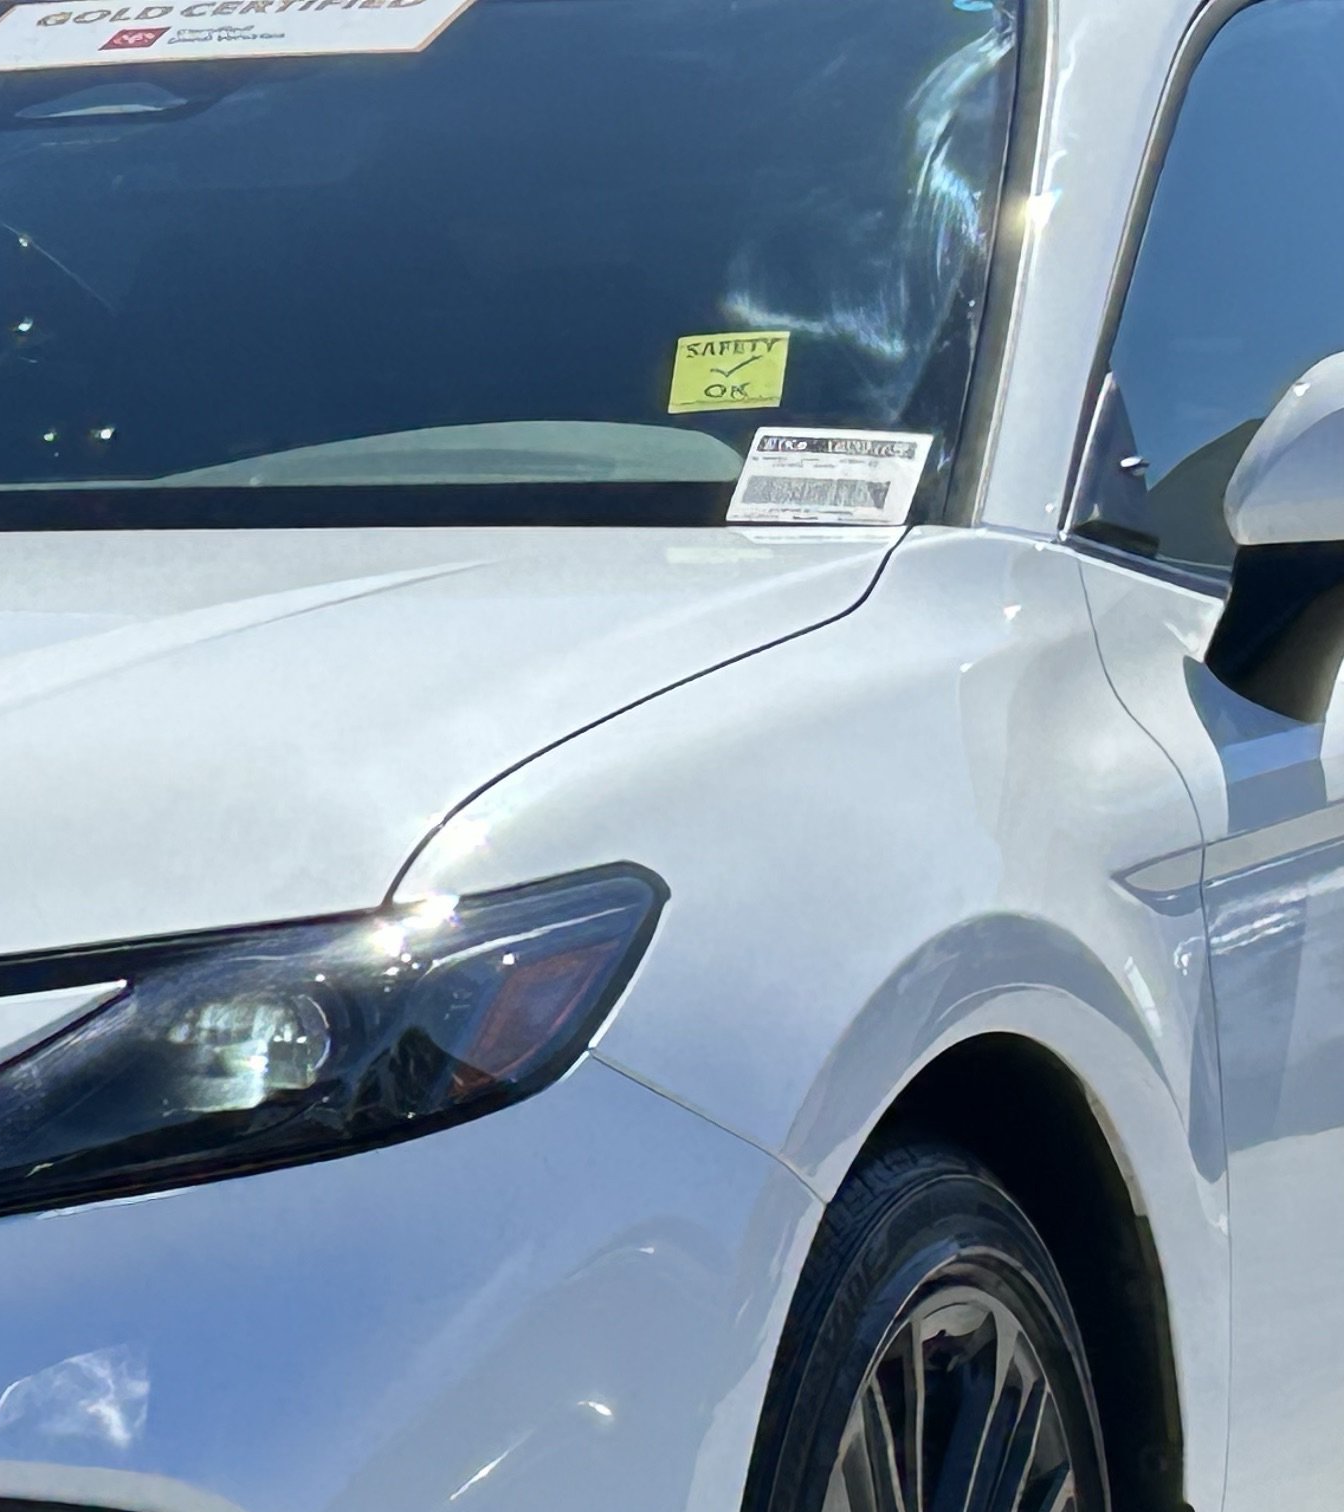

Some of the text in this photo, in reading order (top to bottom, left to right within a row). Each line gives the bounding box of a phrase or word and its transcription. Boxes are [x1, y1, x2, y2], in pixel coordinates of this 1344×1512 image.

[36, 6, 174, 27] GOLD
[685, 338, 783, 358] SAFETY
[703, 382, 751, 400] OK
